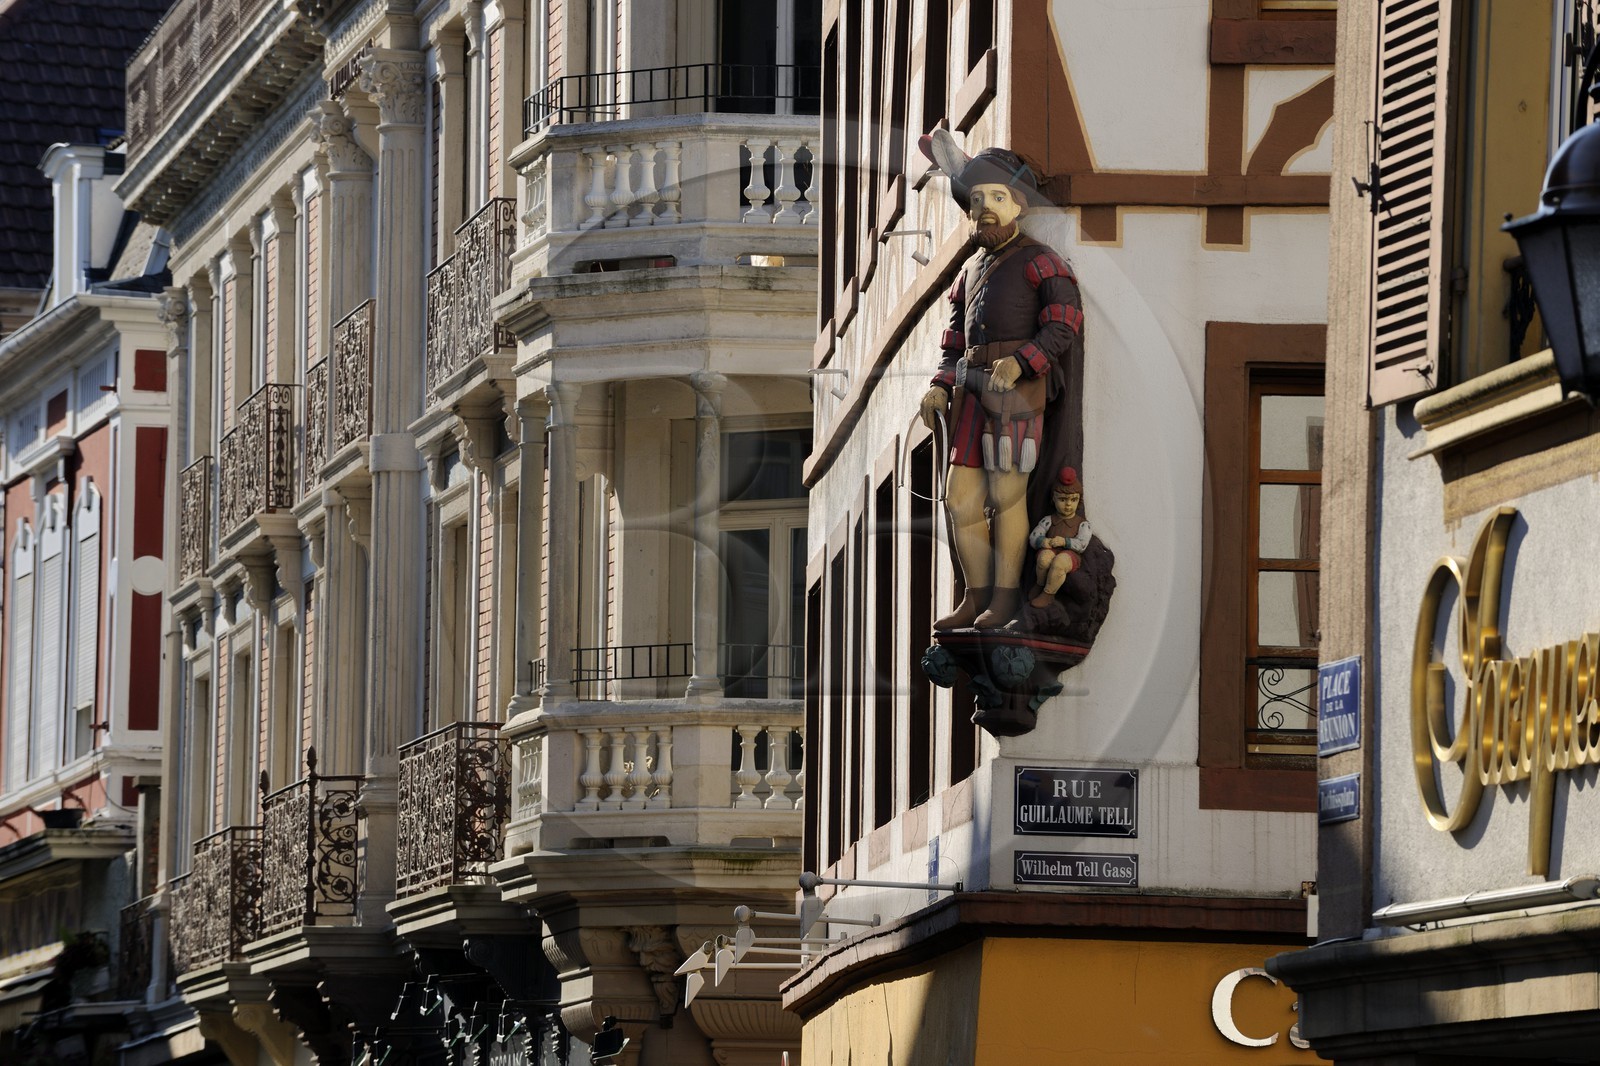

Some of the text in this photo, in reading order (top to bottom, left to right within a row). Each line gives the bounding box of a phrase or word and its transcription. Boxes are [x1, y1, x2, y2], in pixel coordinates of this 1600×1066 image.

[1322, 670, 1351, 701] PLACE
[1325, 700, 1344, 712] DE LA
[1320, 712, 1356, 744] RÉUNION
[1052, 779, 1102, 799] RUE
[1020, 804, 1132, 826] GUILLAUME TELL
[1021, 859, 1132, 878] Wilhelm Tell Gass
